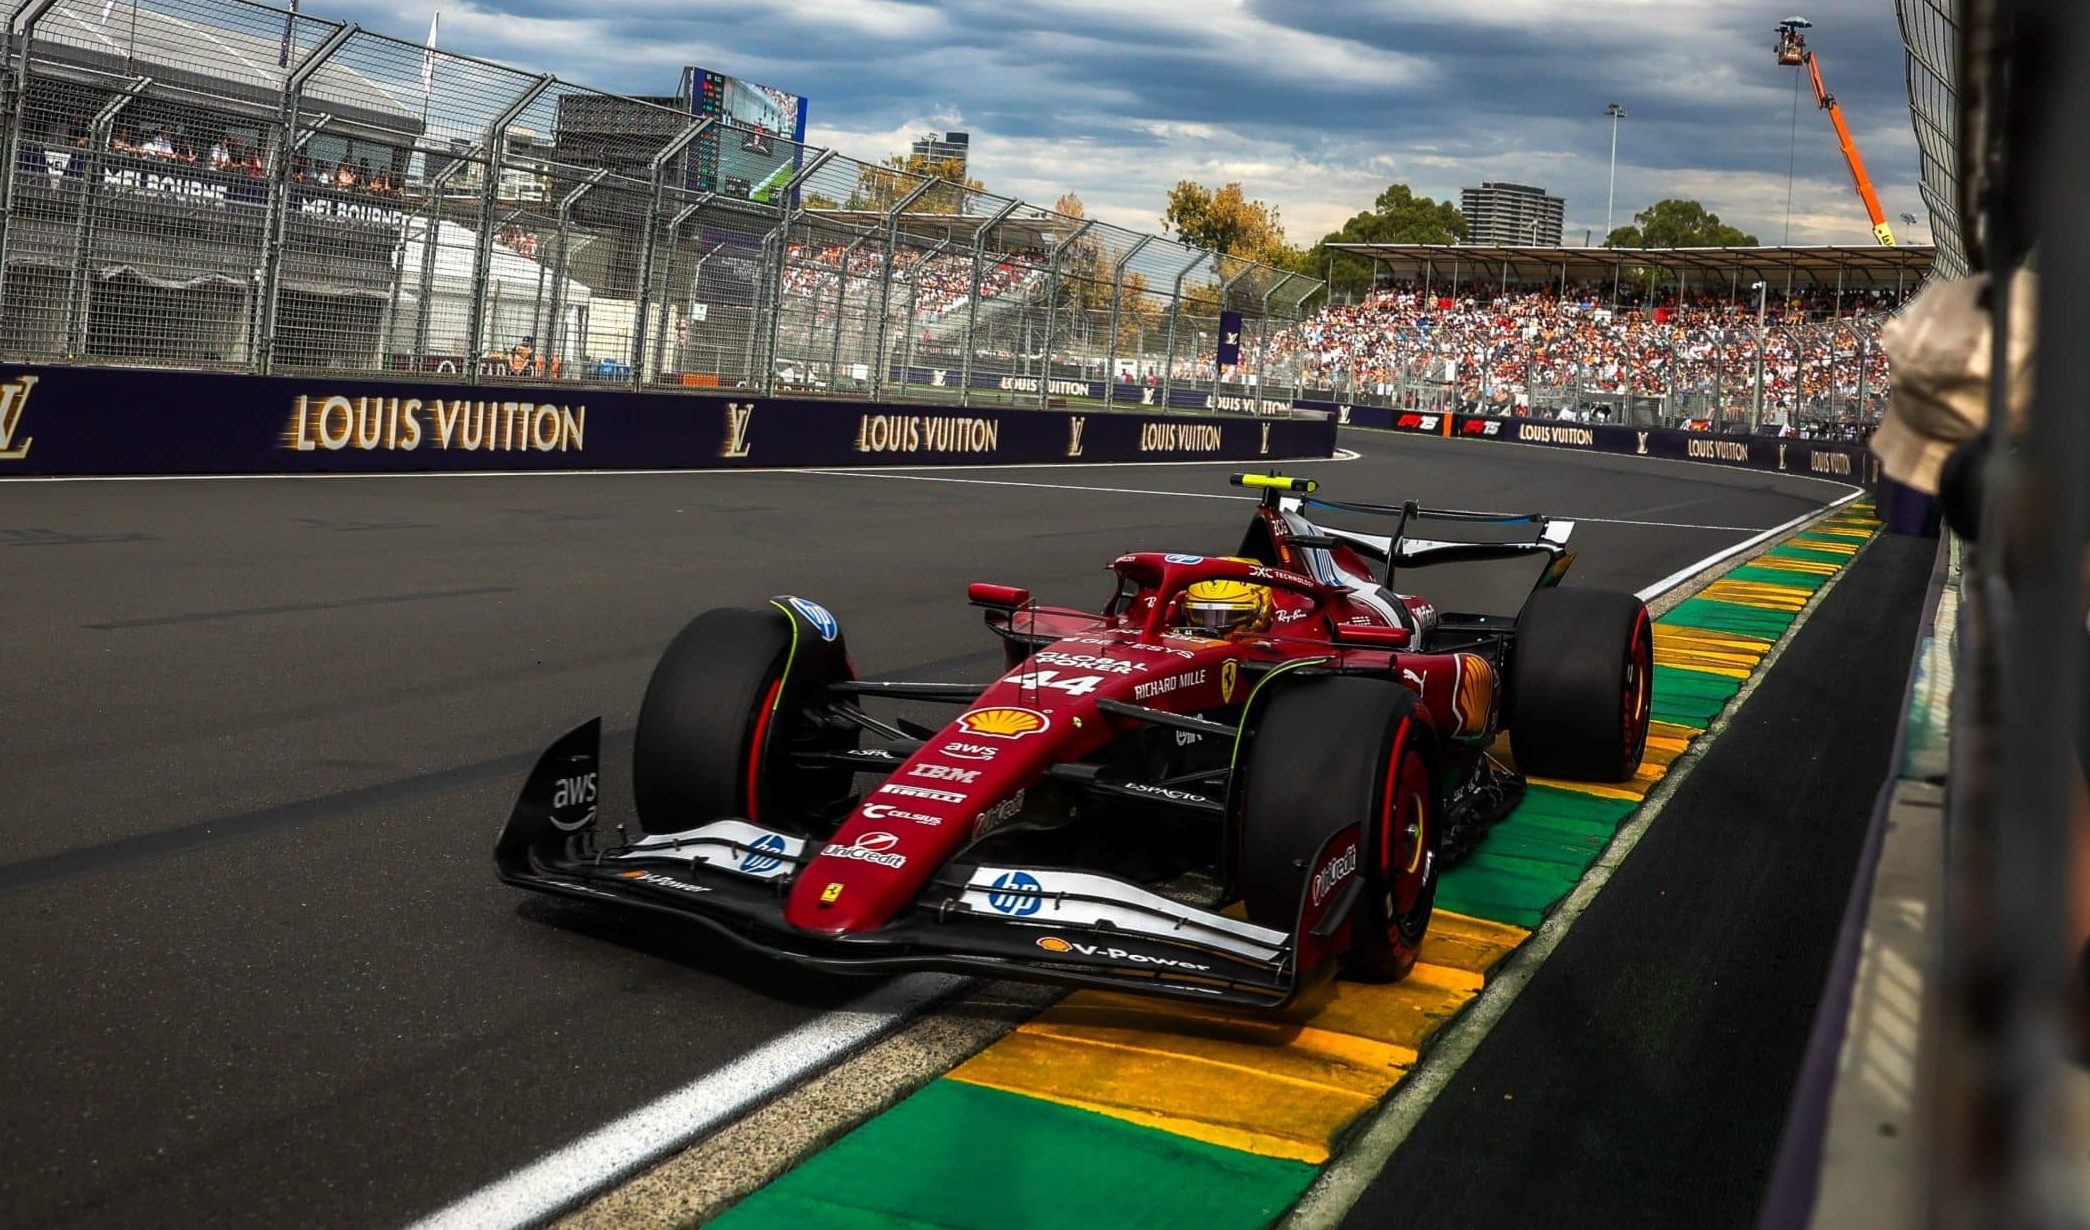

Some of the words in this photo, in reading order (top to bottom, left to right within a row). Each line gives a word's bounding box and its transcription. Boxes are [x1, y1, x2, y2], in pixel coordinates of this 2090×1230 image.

[104, 167, 228, 199] MELBOURNE
[302, 197, 403, 224] MELBOURNE
[1000, 376, 1038, 392] LOUIS
[296, 395, 422, 451] LOUIS
[436, 398, 586, 452] VUITTON
[858, 414, 920, 452] LOUIS
[924, 415, 999, 453] VUITTON
[1519, 423, 1550, 442] LOUIS
[1551, 426, 1593, 446] VUITTON
[1140, 423, 1176, 451] LOUIS
[1178, 424, 1222, 452] VUITTON
[1688, 439, 1714, 458] LOUIS
[1715, 440, 1748, 462] VUITTON
[1811, 450, 1829, 473] LOUIS
[1830, 452, 1851, 476] VUITTON
[1248, 565, 1273, 578] DXC
[1274, 571, 1314, 588] TECHNOLOGY
[1275, 608, 1307, 623] Ray-Ban
[1035, 651, 1149, 672] GLOBAL
[1035, 657, 1133, 675] POKER
[1003, 670, 1105, 696] 44
[1134, 680, 1177, 700] RICHARD
[1179, 669, 1207, 689] MILLE
[945, 742, 999, 756] aws
[907, 763, 982, 784] IBM
[553, 772, 597, 808] aws
[879, 784, 967, 804] PIRELLI
[887, 810, 943, 825] CELSIUS
[821, 845, 906, 868] UniCredit
[992, 872, 1041, 915] hp
[1072, 943, 1211, 972] V-Power
